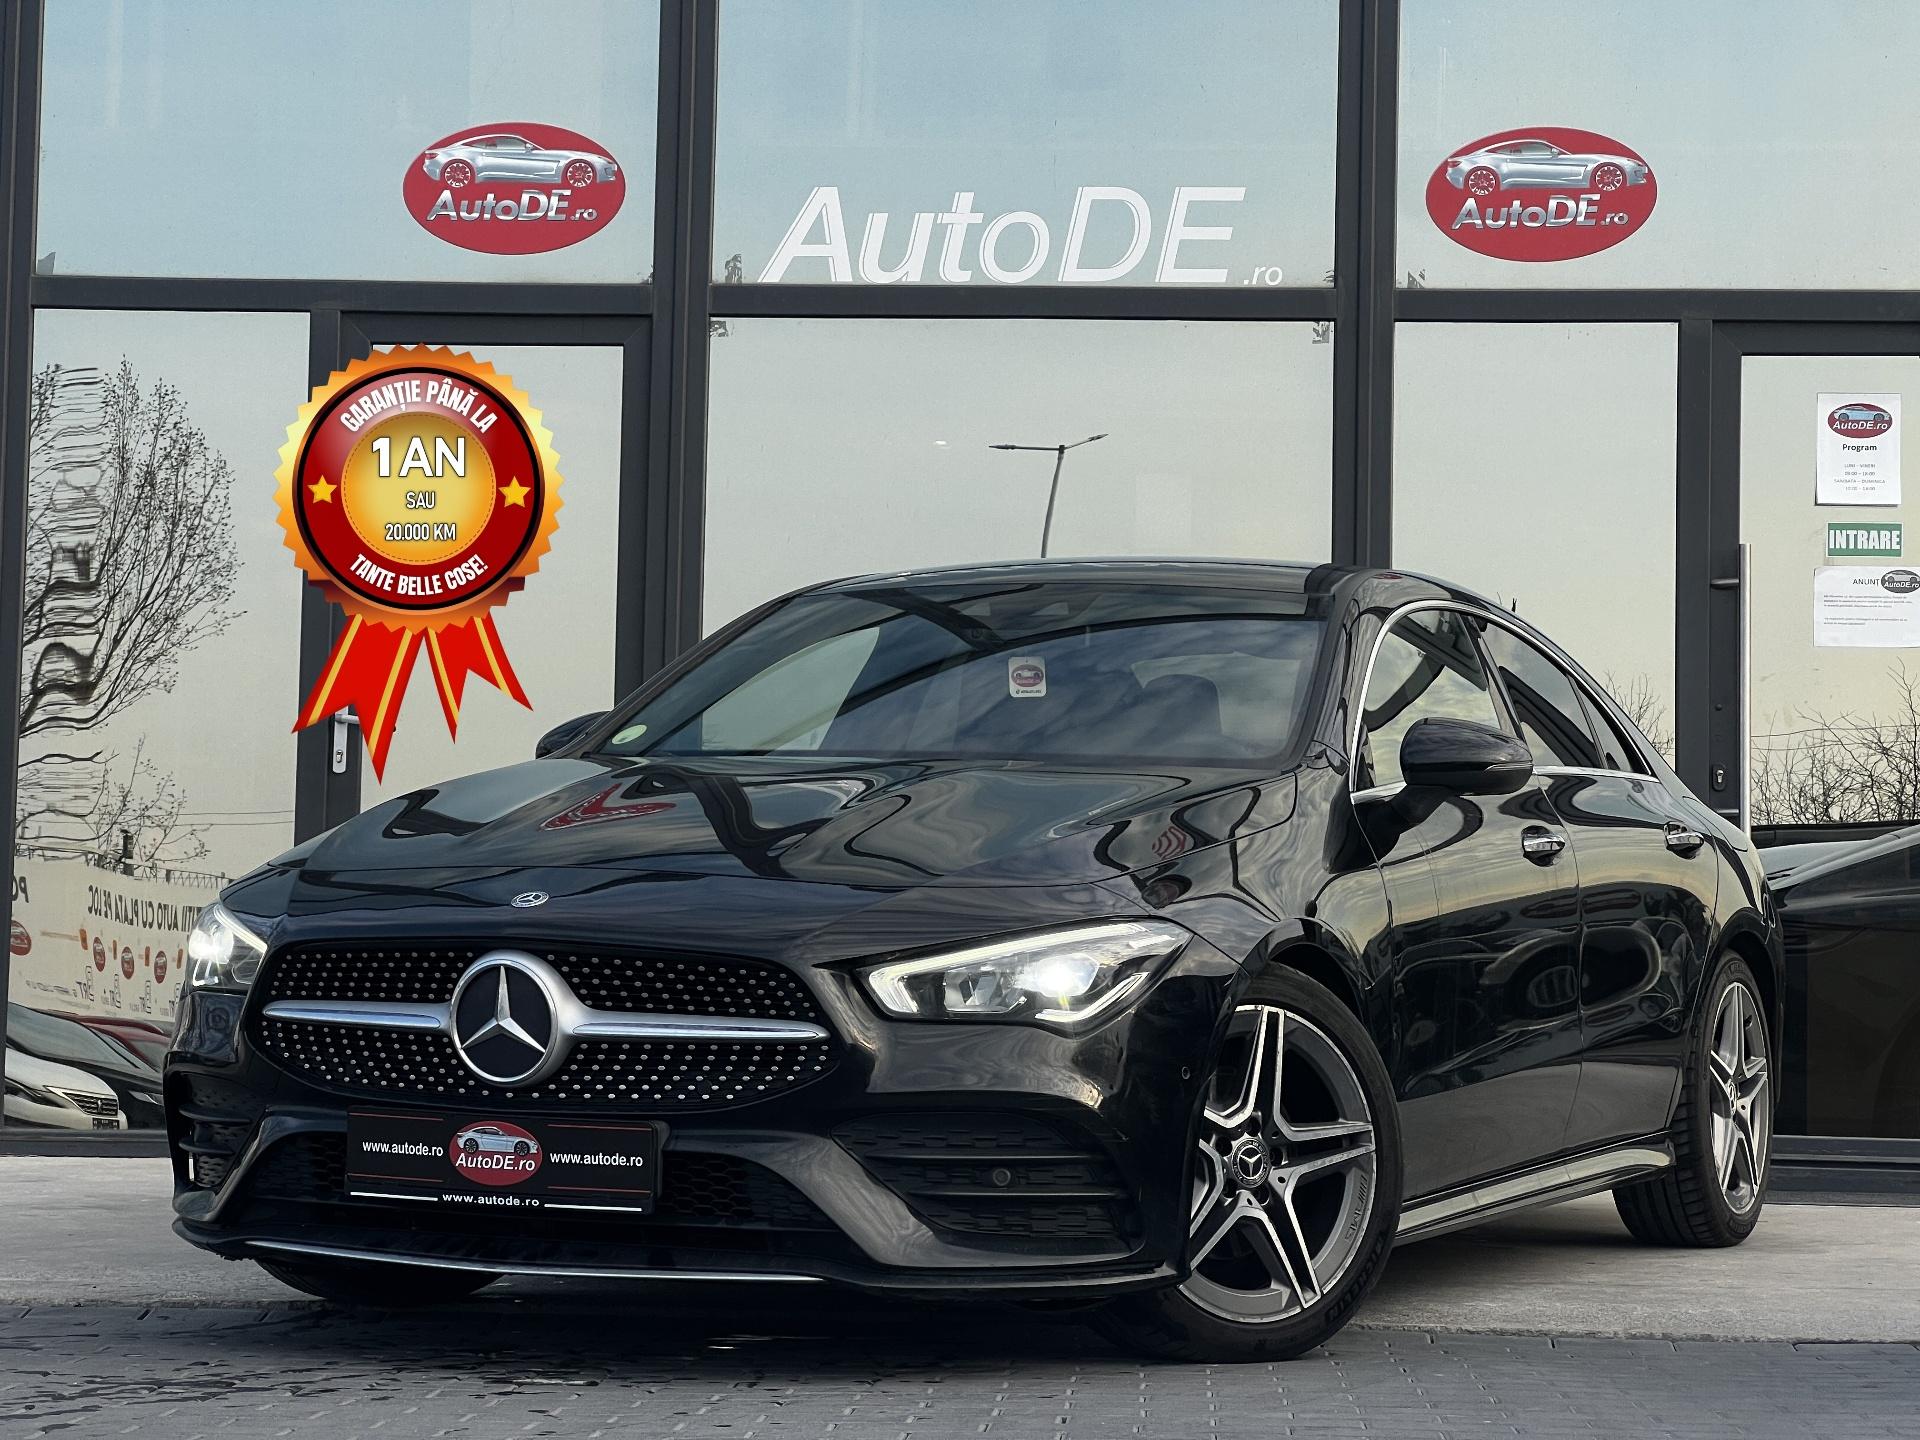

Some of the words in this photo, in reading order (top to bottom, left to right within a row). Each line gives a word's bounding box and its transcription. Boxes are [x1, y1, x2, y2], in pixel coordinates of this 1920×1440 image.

[1832, 421, 1888, 430] AutoDE.ro
[1842, 443, 1878, 453] Program
[1829, 529, 1901, 550] INTRARE
[362, 1140, 444, 1157] www.autode.ro
[455, 1152, 536, 1172] AutoDE.ro
[549, 1152, 643, 1168] www.autode.ro
[442, 1192, 540, 1207] www.autode.ro
